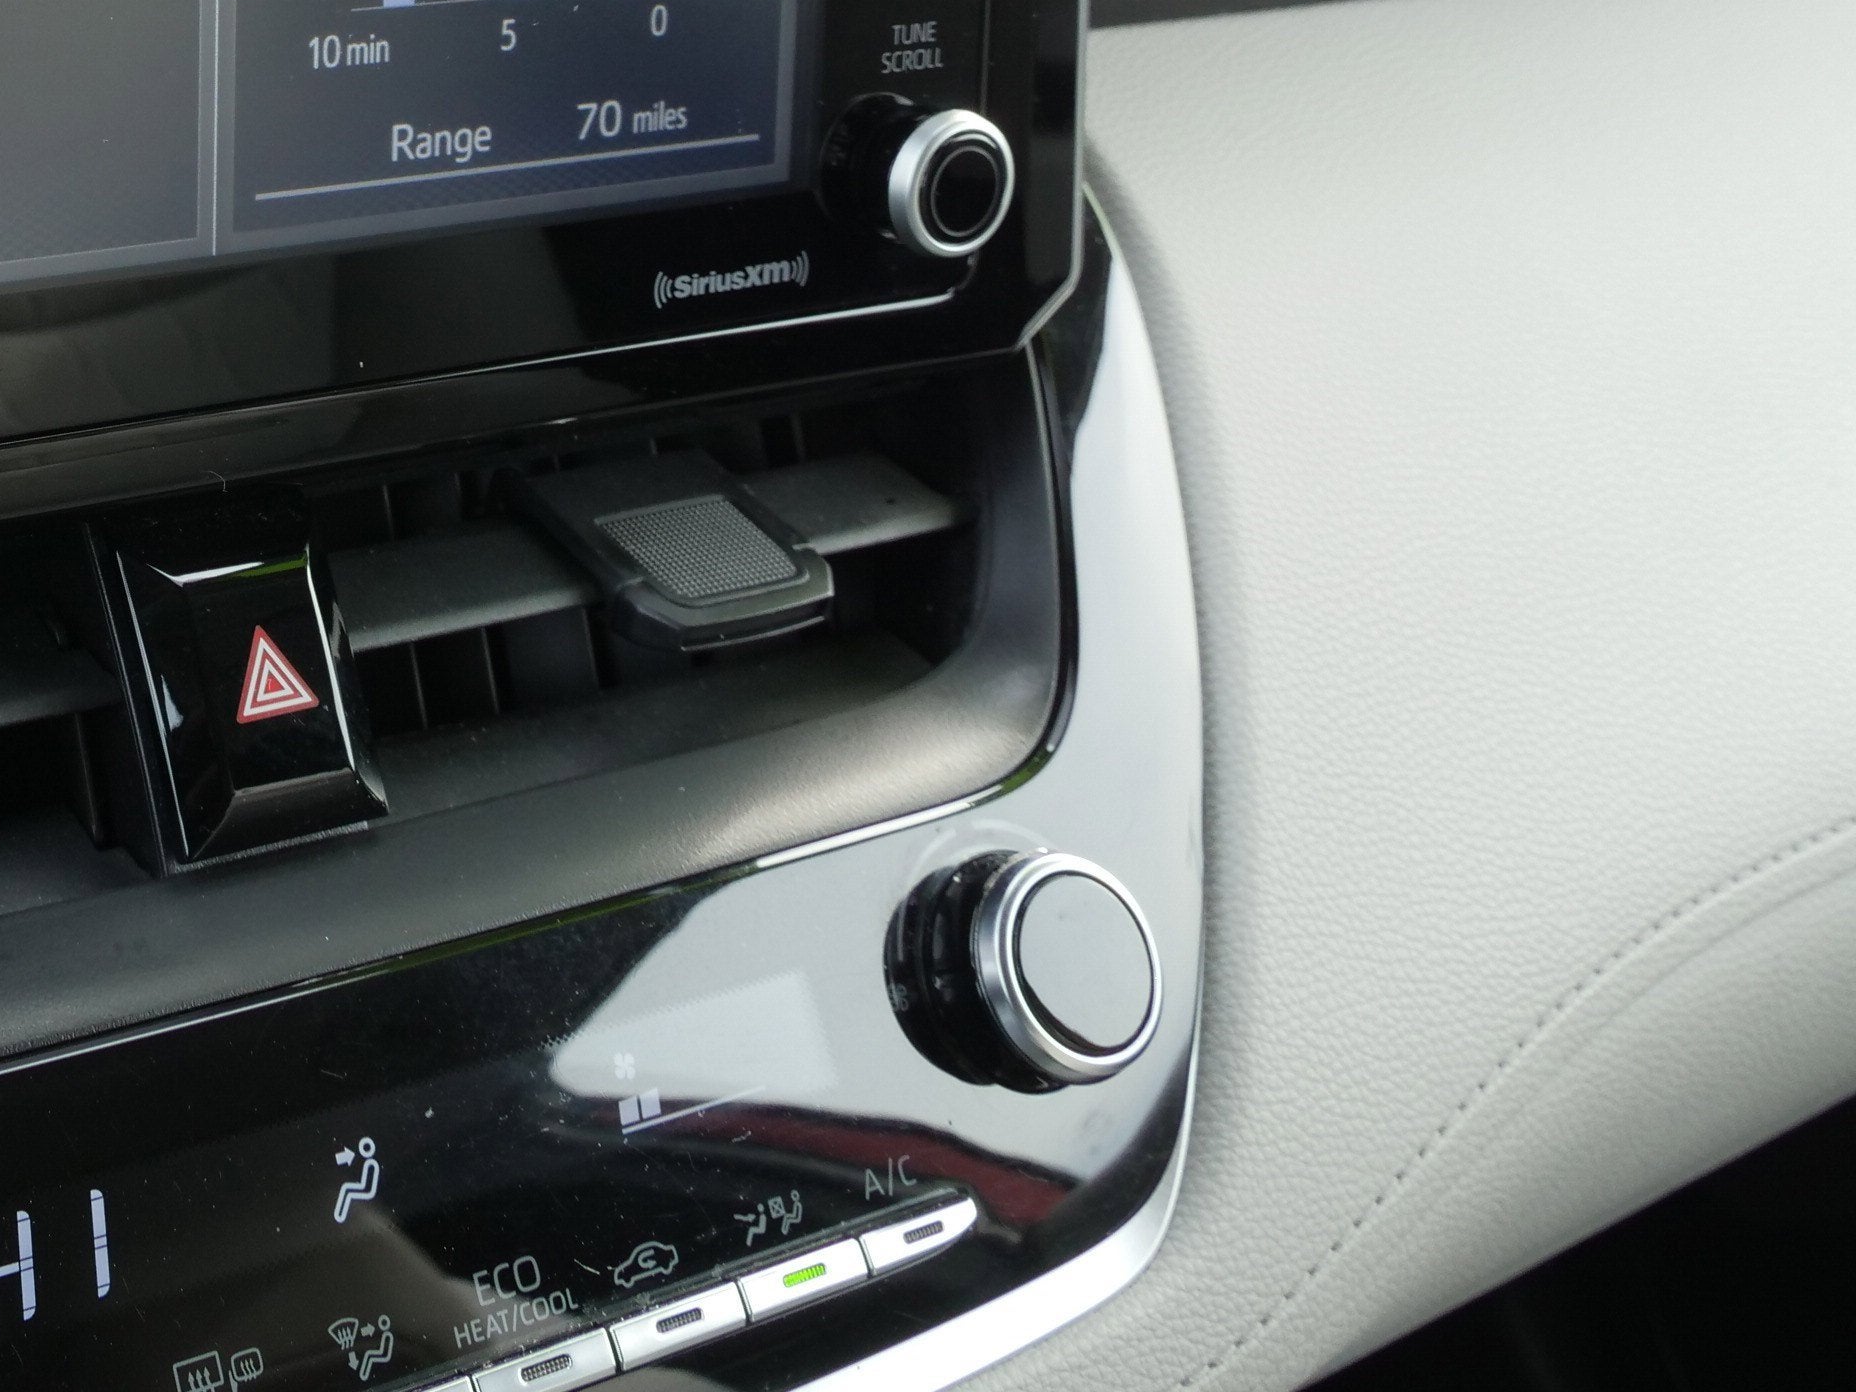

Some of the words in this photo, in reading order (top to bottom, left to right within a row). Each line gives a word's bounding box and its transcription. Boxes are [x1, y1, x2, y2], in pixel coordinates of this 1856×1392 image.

[500, 18, 517, 52] 5
[649, 4, 669, 38] 0
[891, 21, 938, 46] TUNE
[308, 34, 342, 71] 10
[346, 32, 391, 67] min
[880, 47, 944, 75] SCROLL
[576, 99, 623, 141] 70
[632, 100, 689, 135] miles
[390, 122, 493, 164] Range
[862, 1154, 919, 1203] A/C
[472, 1253, 543, 1310] ECO
[452, 1285, 581, 1351] HEAT/COOL
